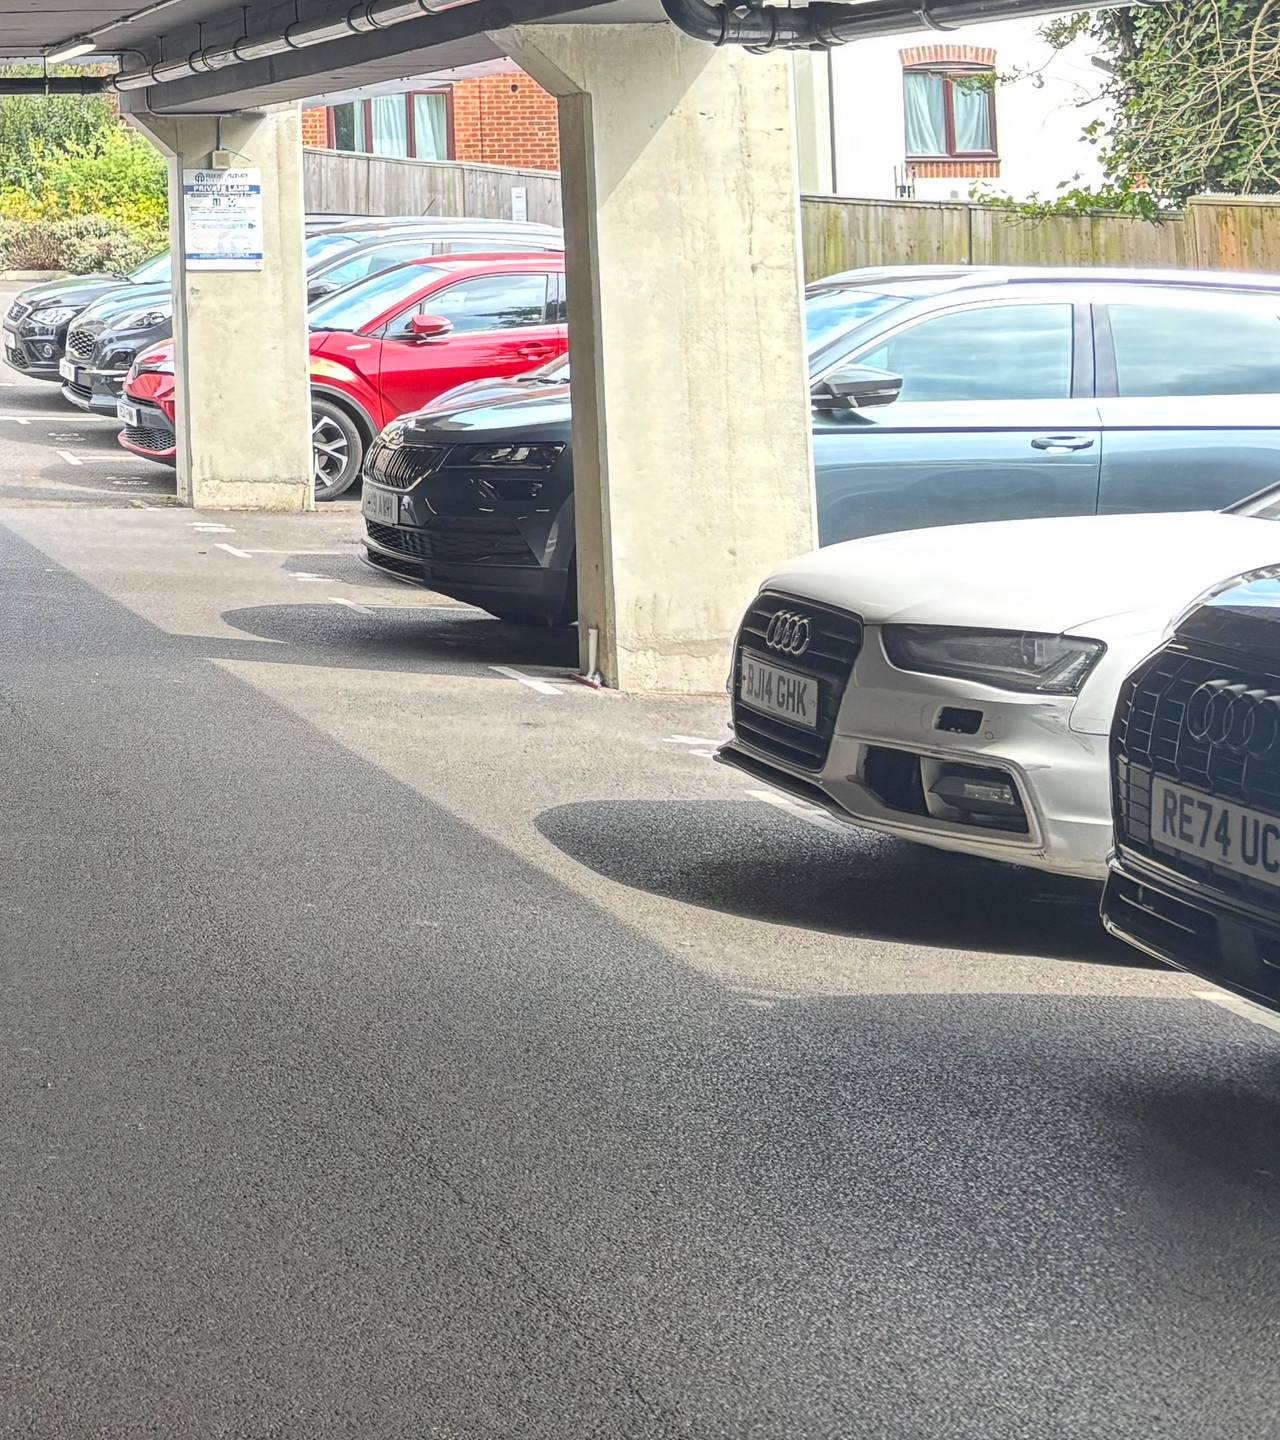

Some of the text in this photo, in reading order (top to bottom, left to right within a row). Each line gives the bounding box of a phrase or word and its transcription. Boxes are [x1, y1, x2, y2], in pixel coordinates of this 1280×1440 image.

[746, 663, 807, 717] BJ14 GHK
[1162, 788, 1231, 857] RE74
